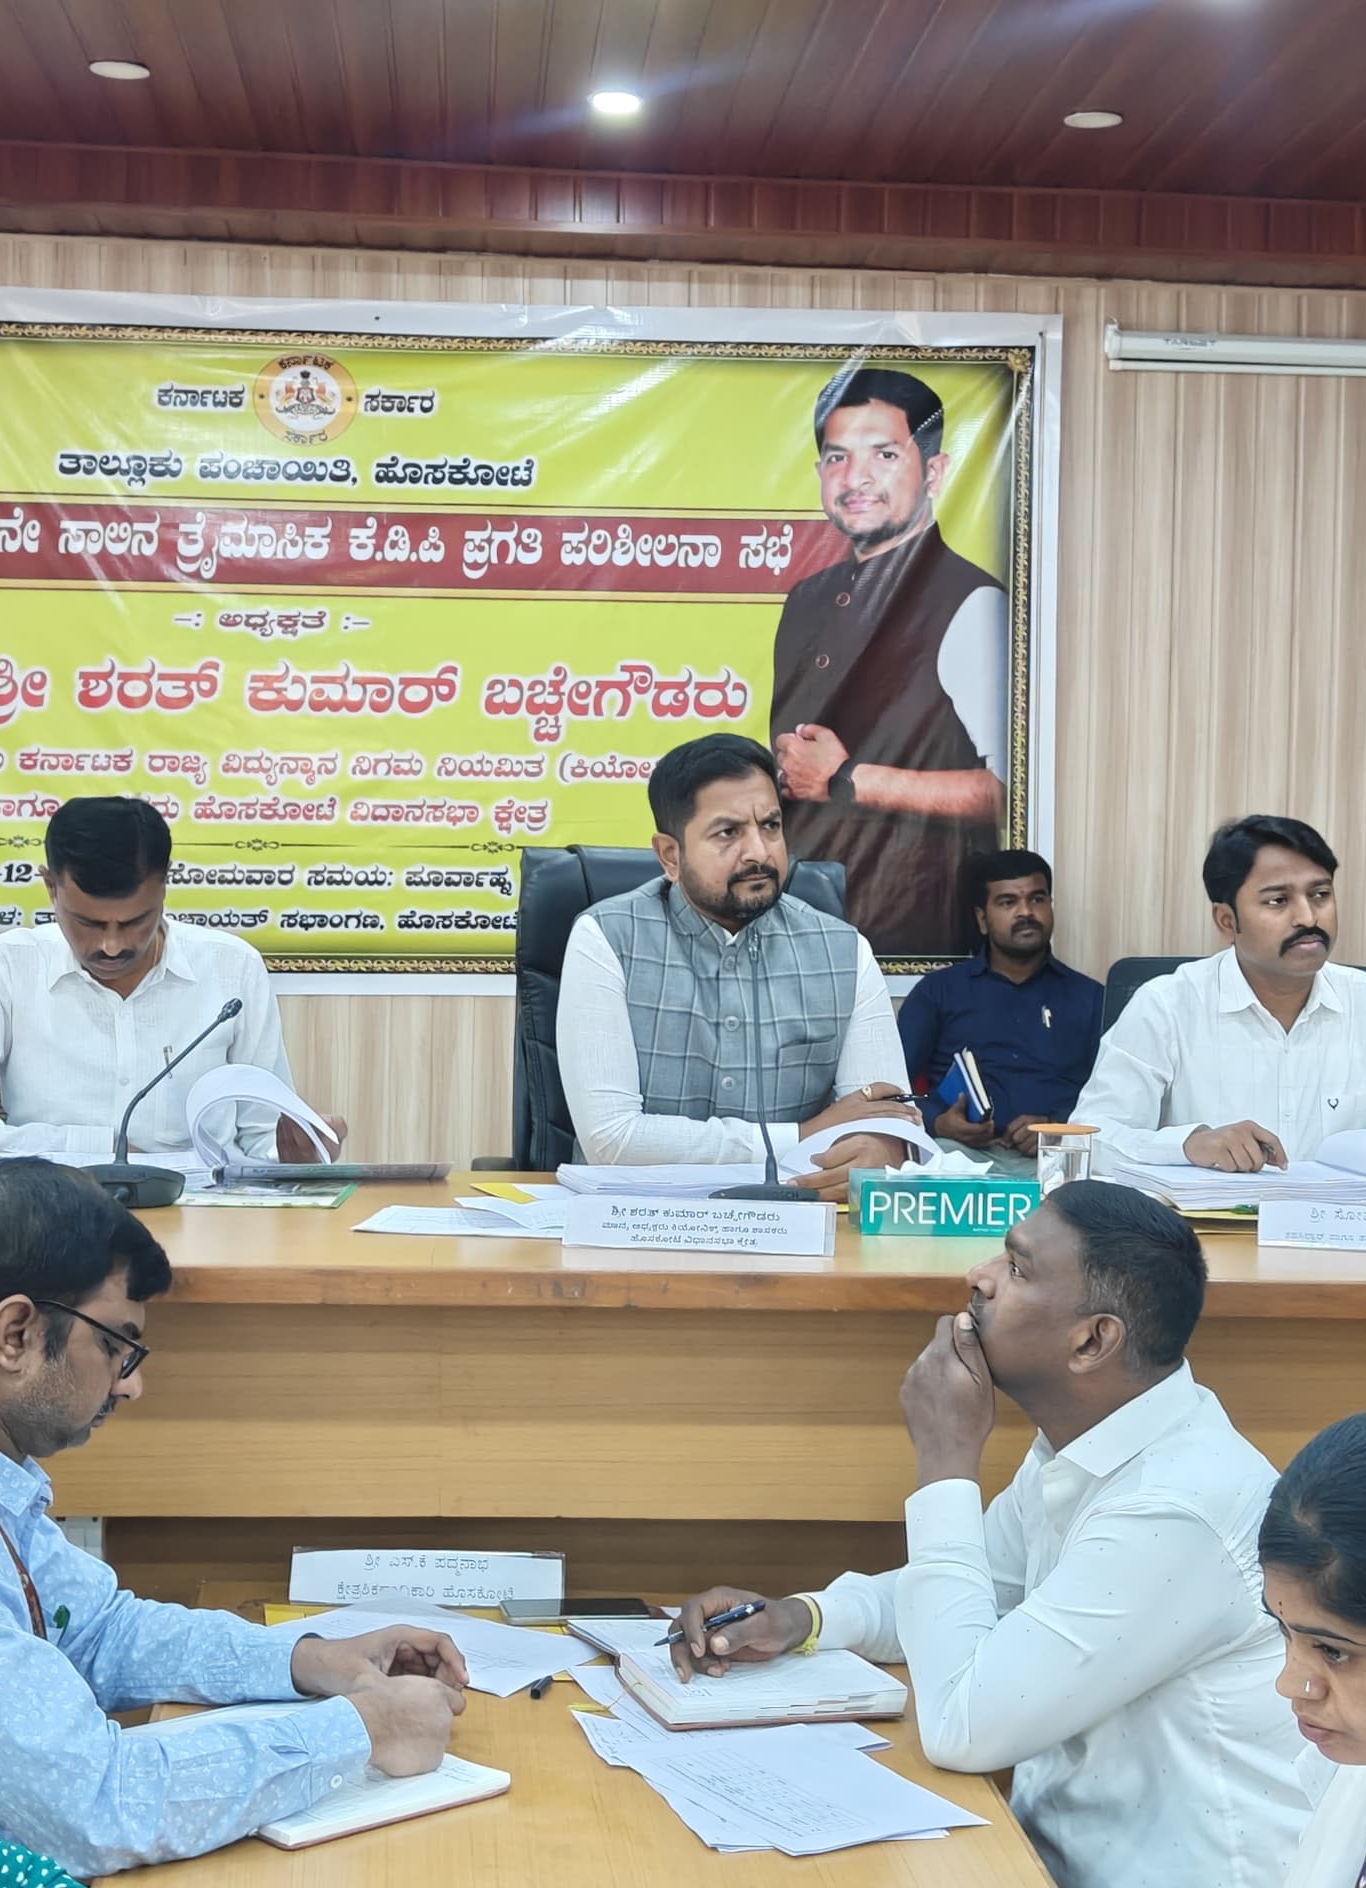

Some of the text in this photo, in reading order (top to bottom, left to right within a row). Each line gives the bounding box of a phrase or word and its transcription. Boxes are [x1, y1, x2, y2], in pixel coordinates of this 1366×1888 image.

[157, 384, 434, 414] ಕರ್ನಾಟಕ ಸರ್ಕಾರ
[58, 450, 535, 488] ತಾಲ್ಲೂಕು ಪಂಚಾಯಿತಿ, ಹೊಸಕೋಟೆ
[58, 513, 160, 556] ಸಾಲಿನ
[176, 512, 332, 580] ತ್ರೈಮಾಸಿಕ
[348, 516, 445, 563] ಕೆ.ಡಿ.ಪಿ
[462, 519, 543, 579] ಪ್ರಗತಿ
[561, 520, 722, 569] ಪರಿಶೀಲನಾ
[739, 524, 793, 575] ಸಭೆ
[219, 610, 326, 638] ಅಧ್ಯಕ್ಷತೆ
[78, 657, 221, 710] ಶರತ್
[248, 661, 459, 715] ಕುಮಾರ್
[484, 664, 748, 744] ಬಚ್ಚೇಗೌಡರು
[18, 747, 134, 773] ಕರ್ನಾಟಕ
[148, 753, 208, 785] ರಾಜ್ಯ
[221, 751, 339, 786] ವಿದ್ಯುನ್ಮಾನ
[351, 754, 423, 779] ನಿಗಮ
[437, 754, 545, 780] ನಿಯಮಿತ
[559, 753, 652, 783] (ಕಿಯೋ
[194, 795, 336, 822] ಹೊಸಕೋಟೆ
[494, 799, 549, 834] ಕ್ಷೇತ್ರ
[307, 864, 393, 888] ಸಮಯ:
[405, 866, 513, 896] ಪೂರ್ವಾಹ್ನ
[869, 1191, 1031, 1226] PREMIER
